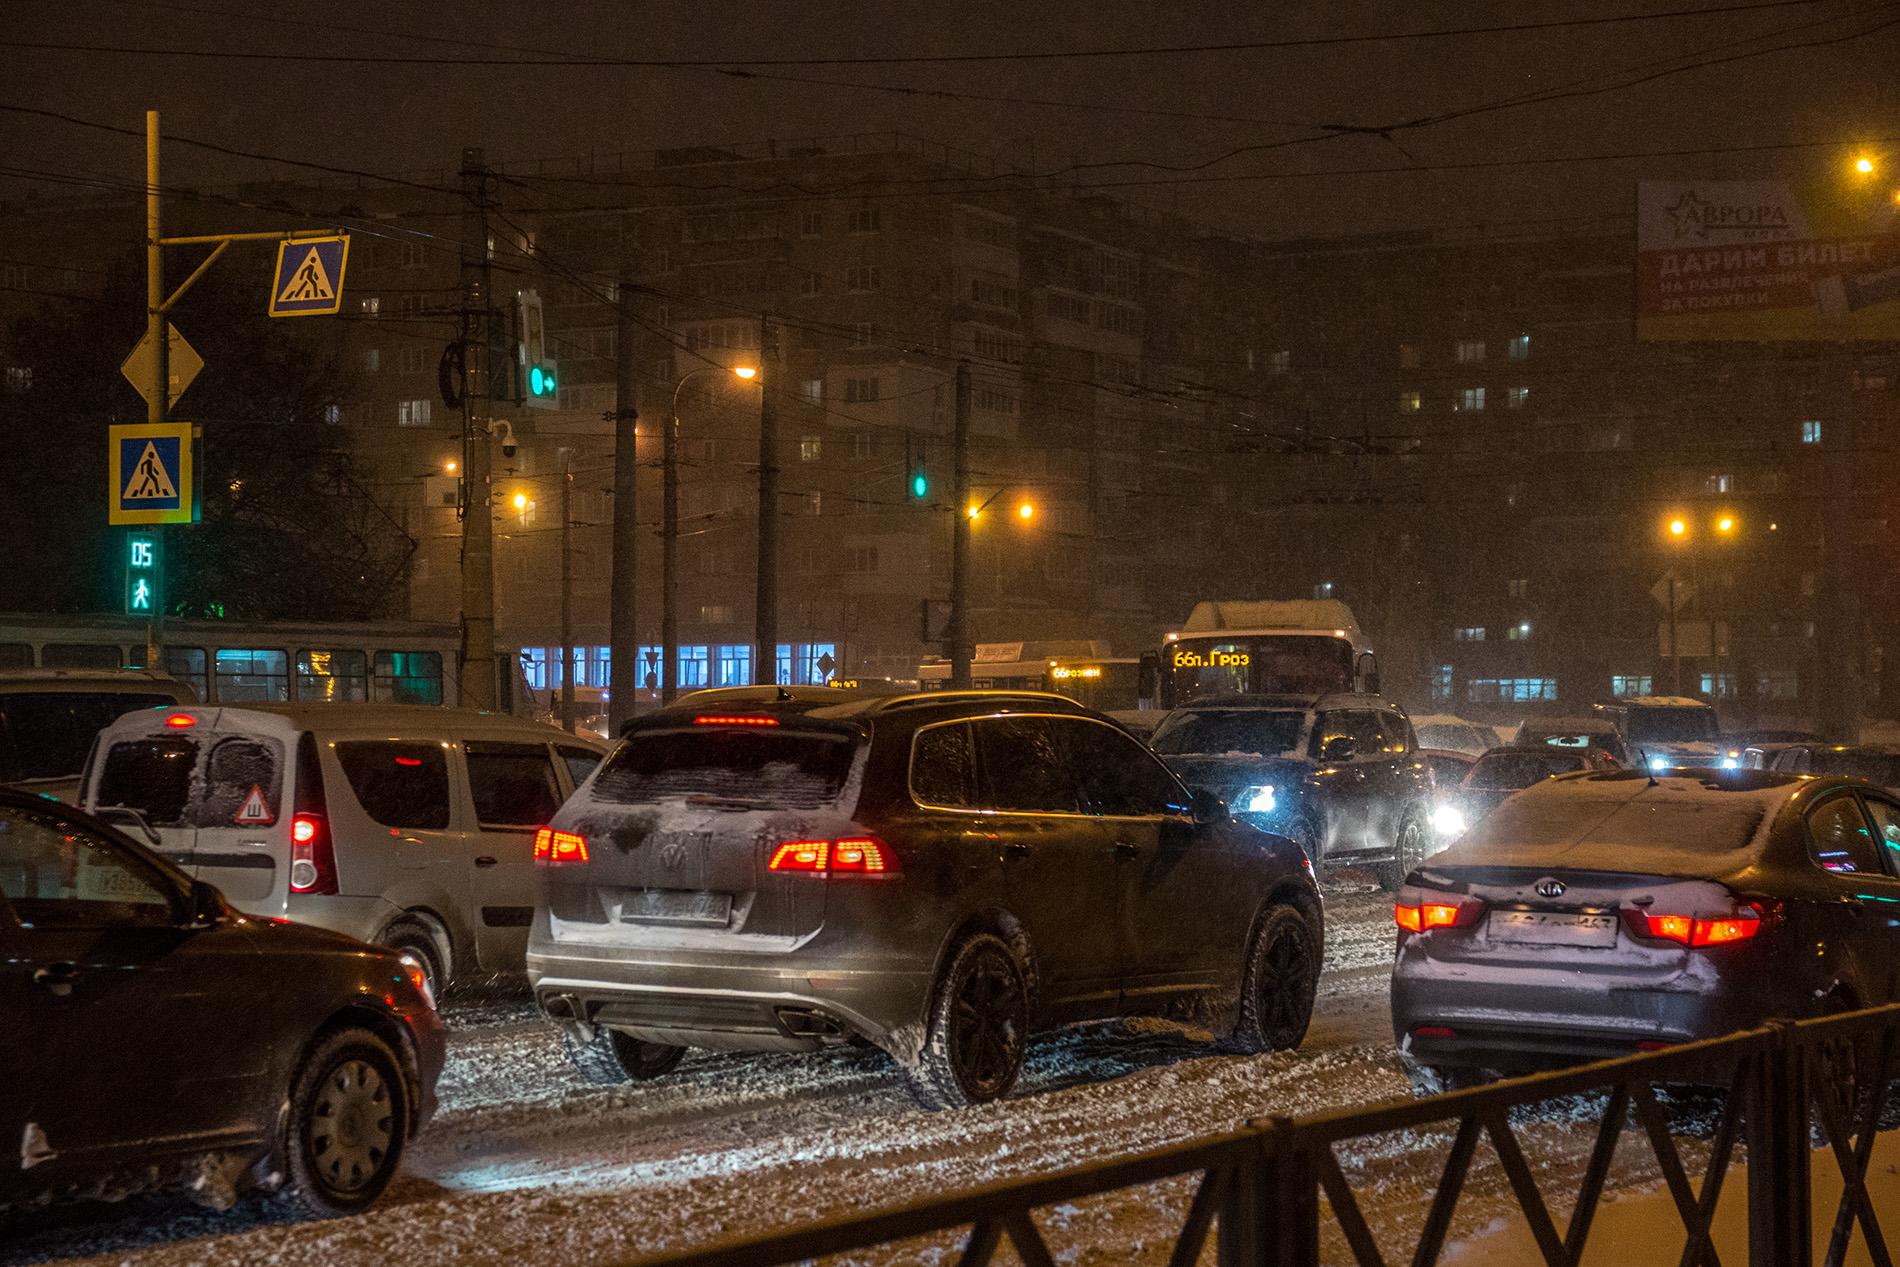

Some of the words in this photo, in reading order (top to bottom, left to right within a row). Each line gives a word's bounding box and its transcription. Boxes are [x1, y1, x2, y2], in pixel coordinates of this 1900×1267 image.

[1686, 206, 1788, 224] АВРОРА
[1660, 248, 1767, 277] ДАРИМ
[131, 542, 152, 566] 05
[248, 804, 261, 817] Ш
[1537, 880, 1563, 895] KIA
